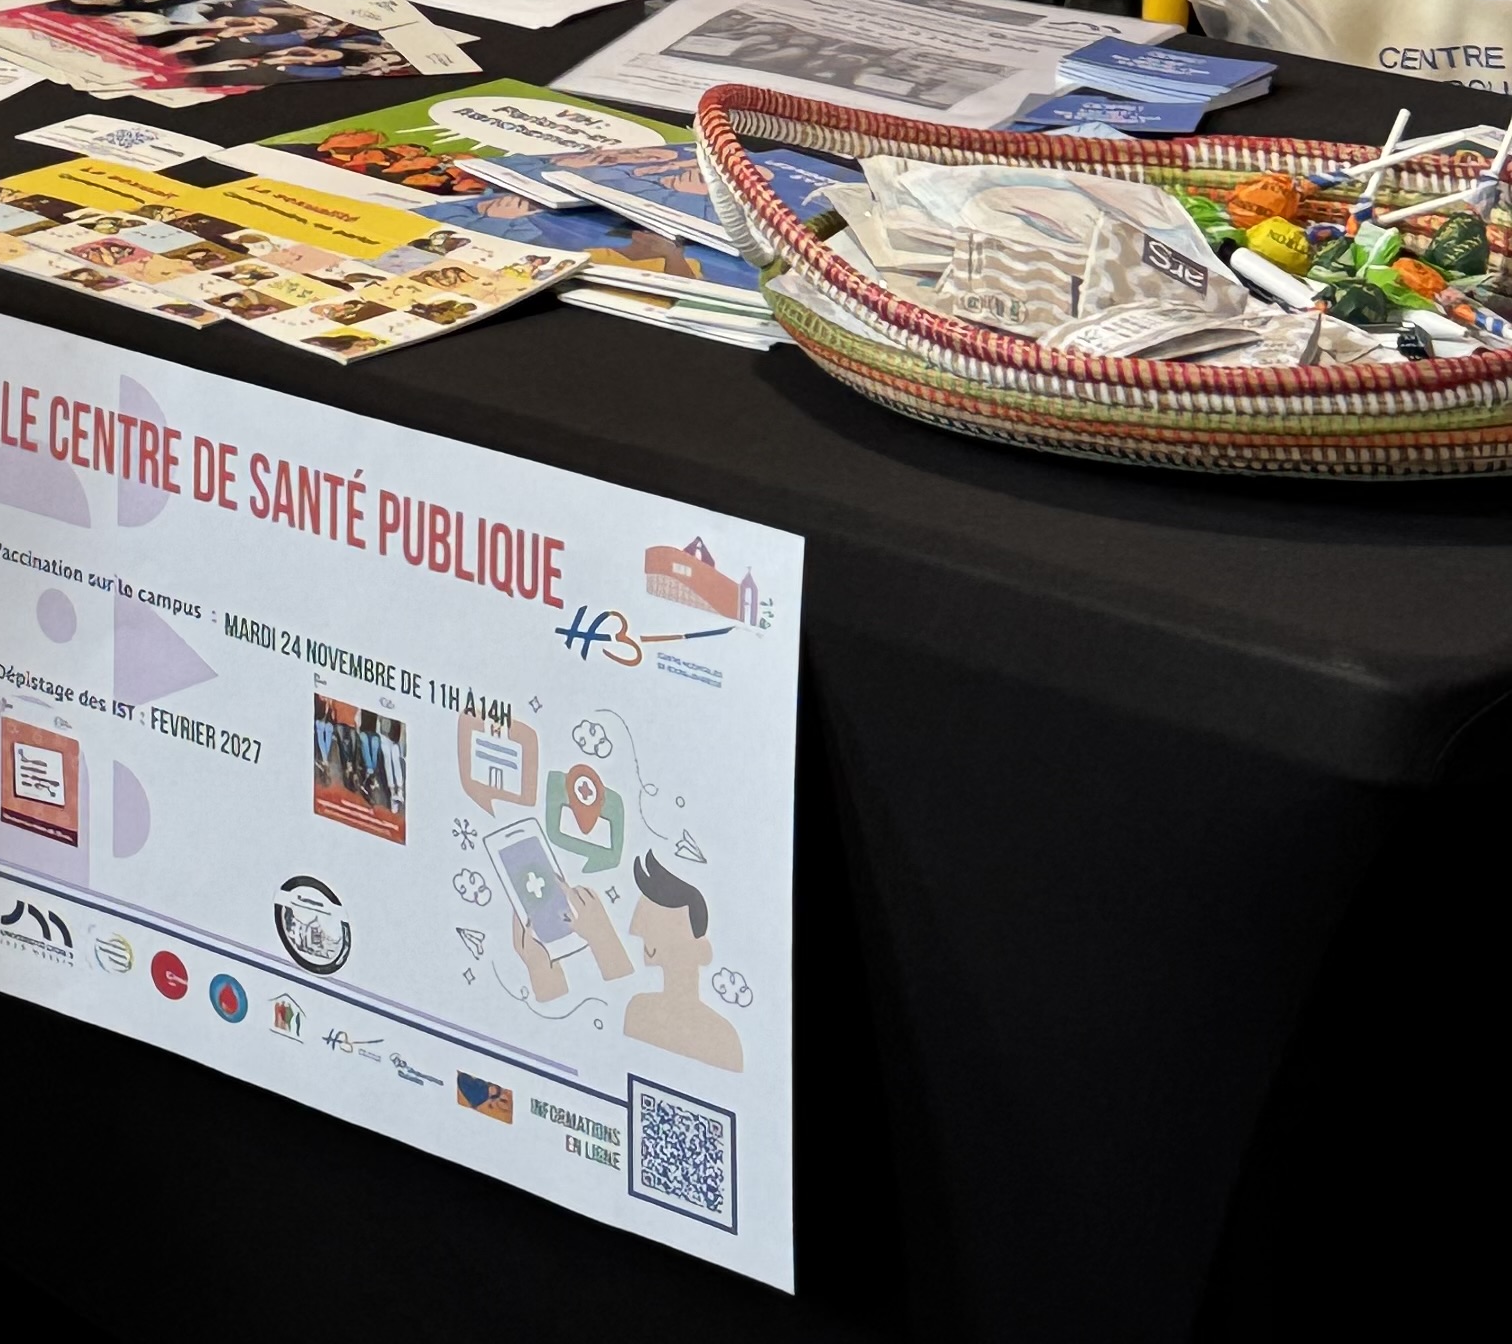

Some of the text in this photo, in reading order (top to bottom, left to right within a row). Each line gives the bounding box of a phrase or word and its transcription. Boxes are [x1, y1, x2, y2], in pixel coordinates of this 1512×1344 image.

[1378, 45, 1506, 71] CENTRE
[0, 379, 566, 611] LE CENTRE DE SANTÉ PUBLIQUE
[137, 586, 203, 620] campus
[223, 612, 277, 653] MARDI
[280, 630, 303, 660] 24
[304, 637, 397, 690] NOVEMBRE
[399, 669, 423, 701] DE
[428, 679, 460, 712] 11H
[79, 685, 108, 710] des
[111, 700, 136, 722] IST
[149, 706, 218, 752] FEVRIER
[220, 730, 263, 766] 2027
[530, 1097, 621, 1147] INFORMATIONS
[584, 1141, 622, 1171] LIGNE
